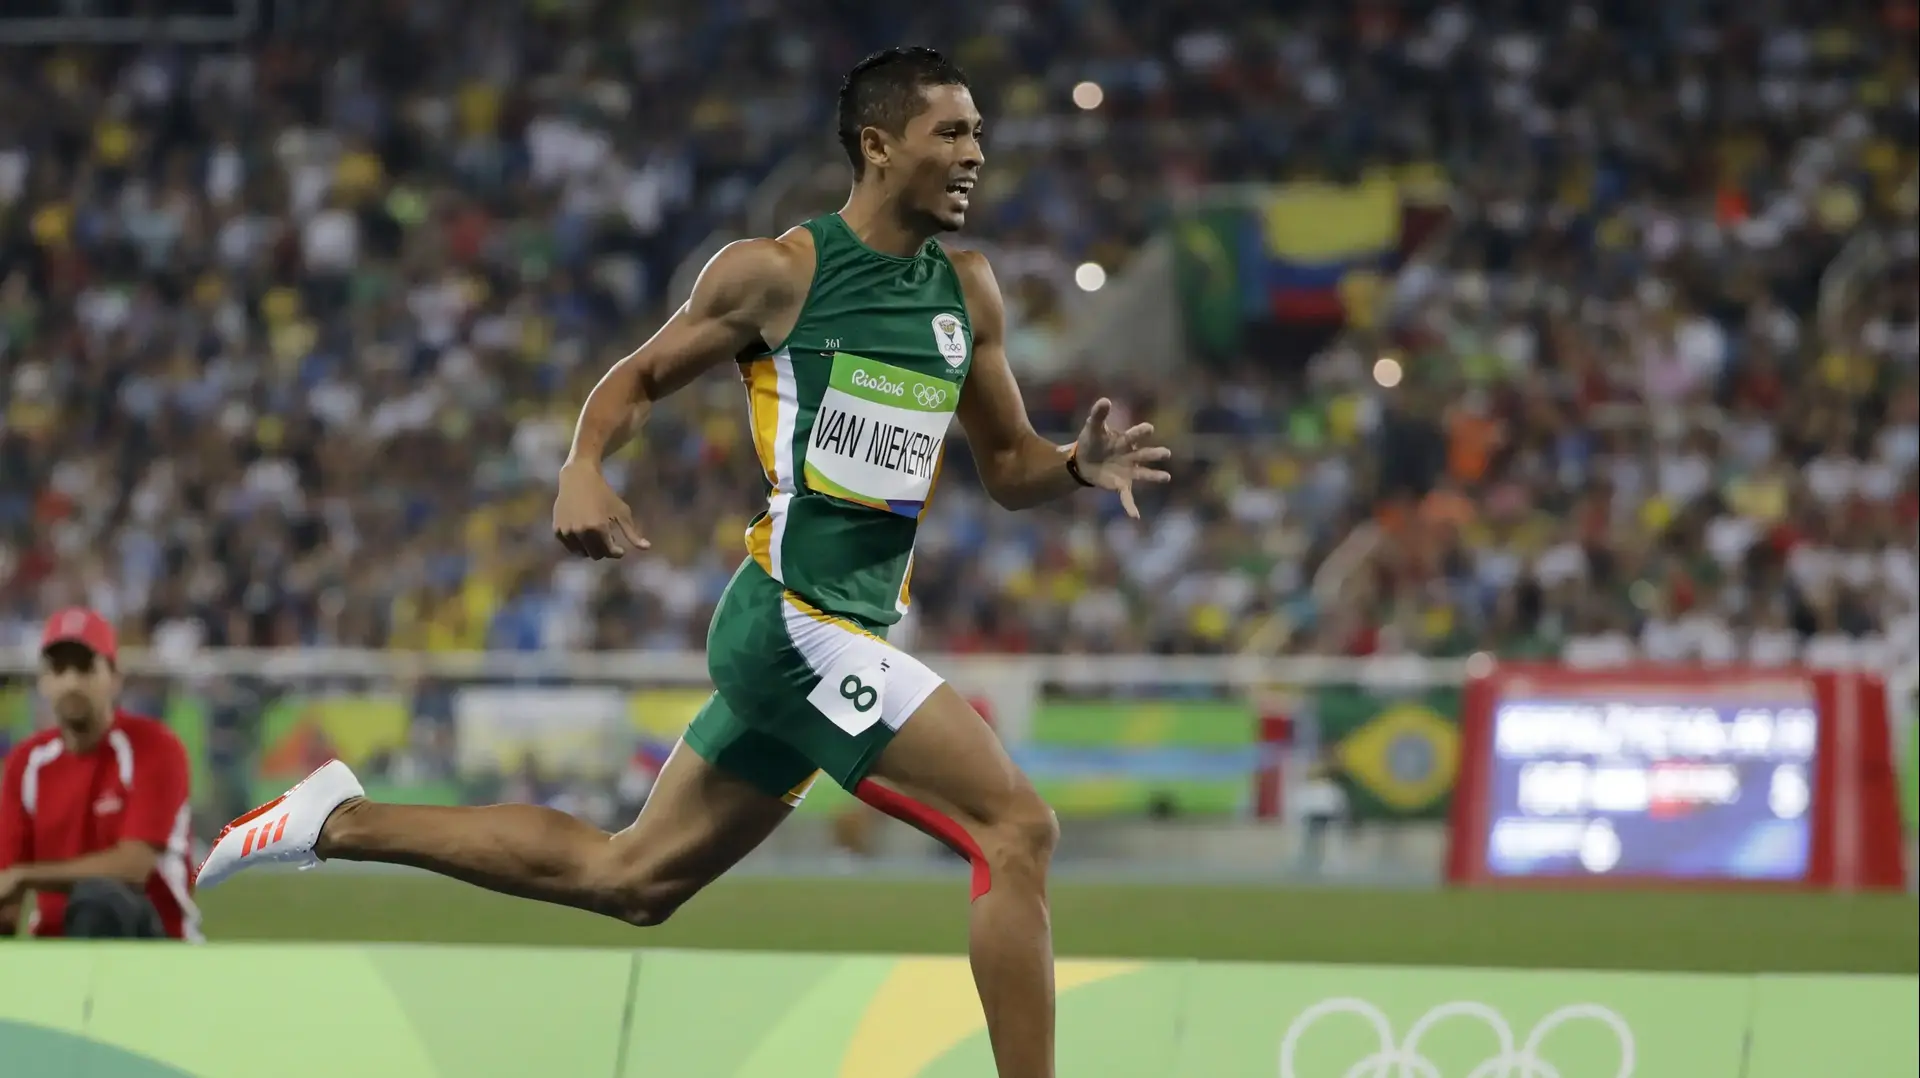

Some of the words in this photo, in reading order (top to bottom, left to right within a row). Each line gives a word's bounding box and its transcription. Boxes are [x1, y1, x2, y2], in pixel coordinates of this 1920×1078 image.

[815, 406, 866, 459] VAN
[865, 421, 941, 480] NIEKERK
[840, 674, 878, 713] 8
